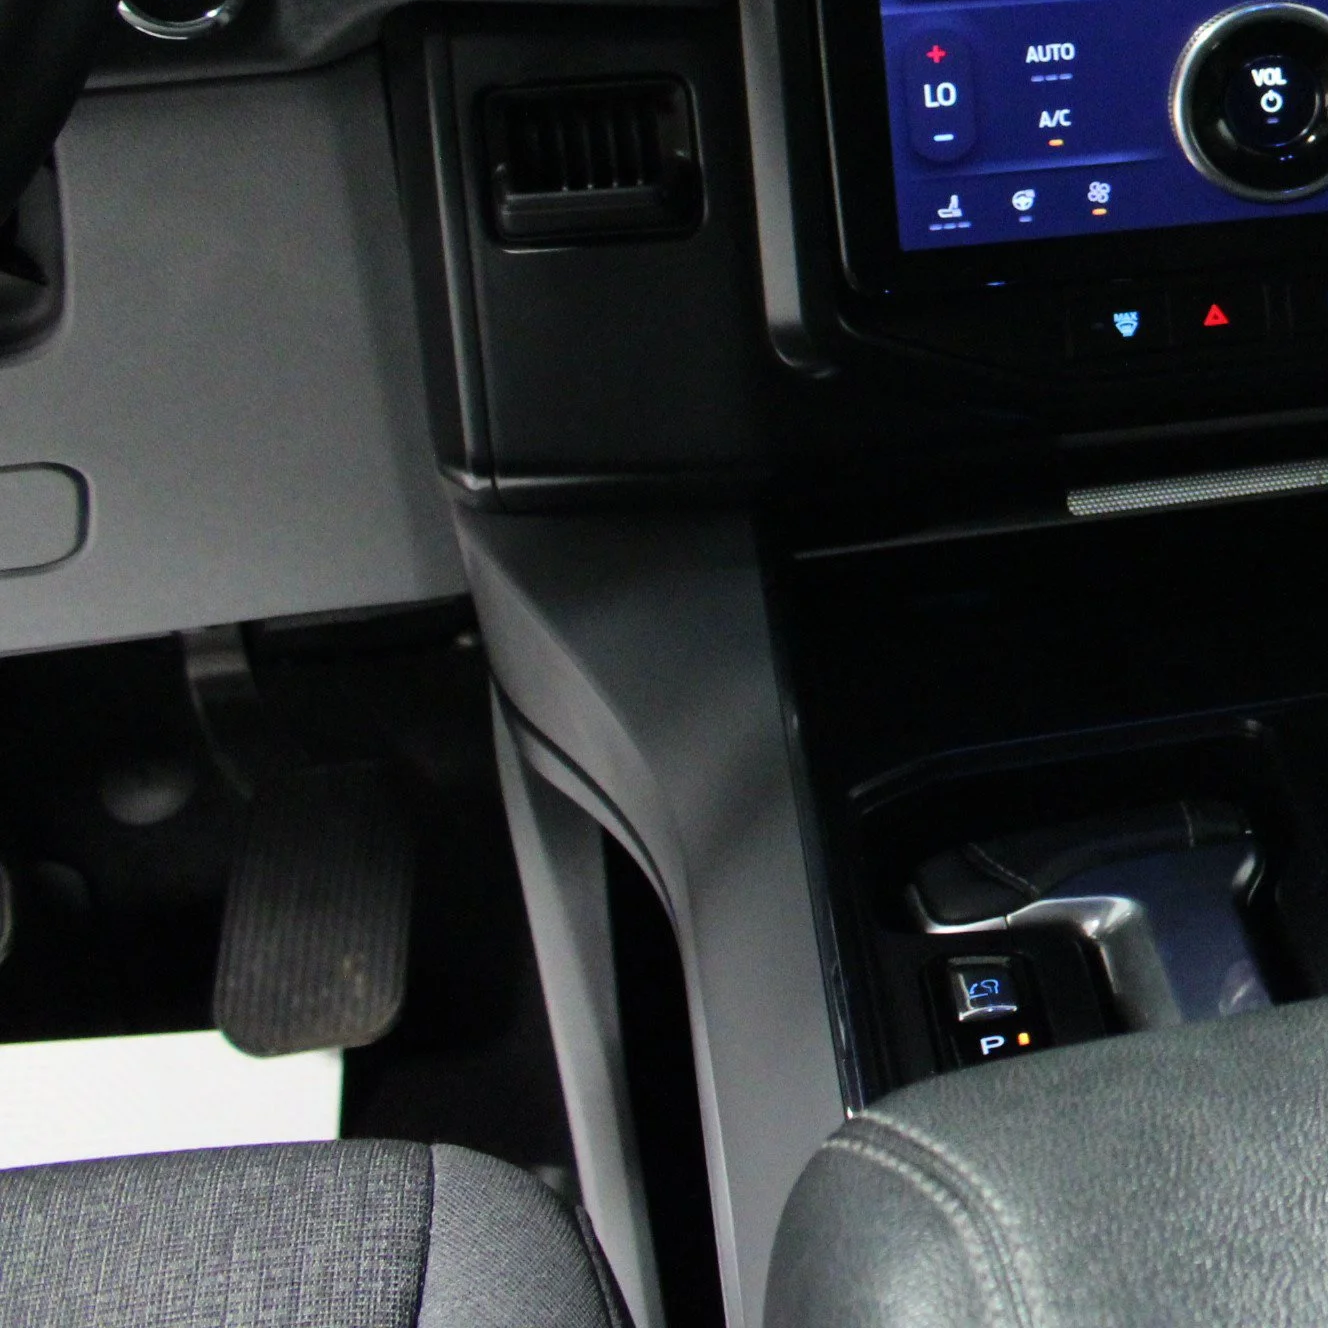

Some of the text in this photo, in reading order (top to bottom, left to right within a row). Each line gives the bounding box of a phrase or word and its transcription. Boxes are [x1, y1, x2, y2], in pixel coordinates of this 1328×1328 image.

[1025, 42, 1076, 64] AUTO
[1250, 66, 1288, 88] VOL
[923, 81, 957, 108] LO
[1038, 108, 1072, 129] A/C
[1113, 311, 1139, 323] MAX
[979, 1035, 1005, 1056] P
